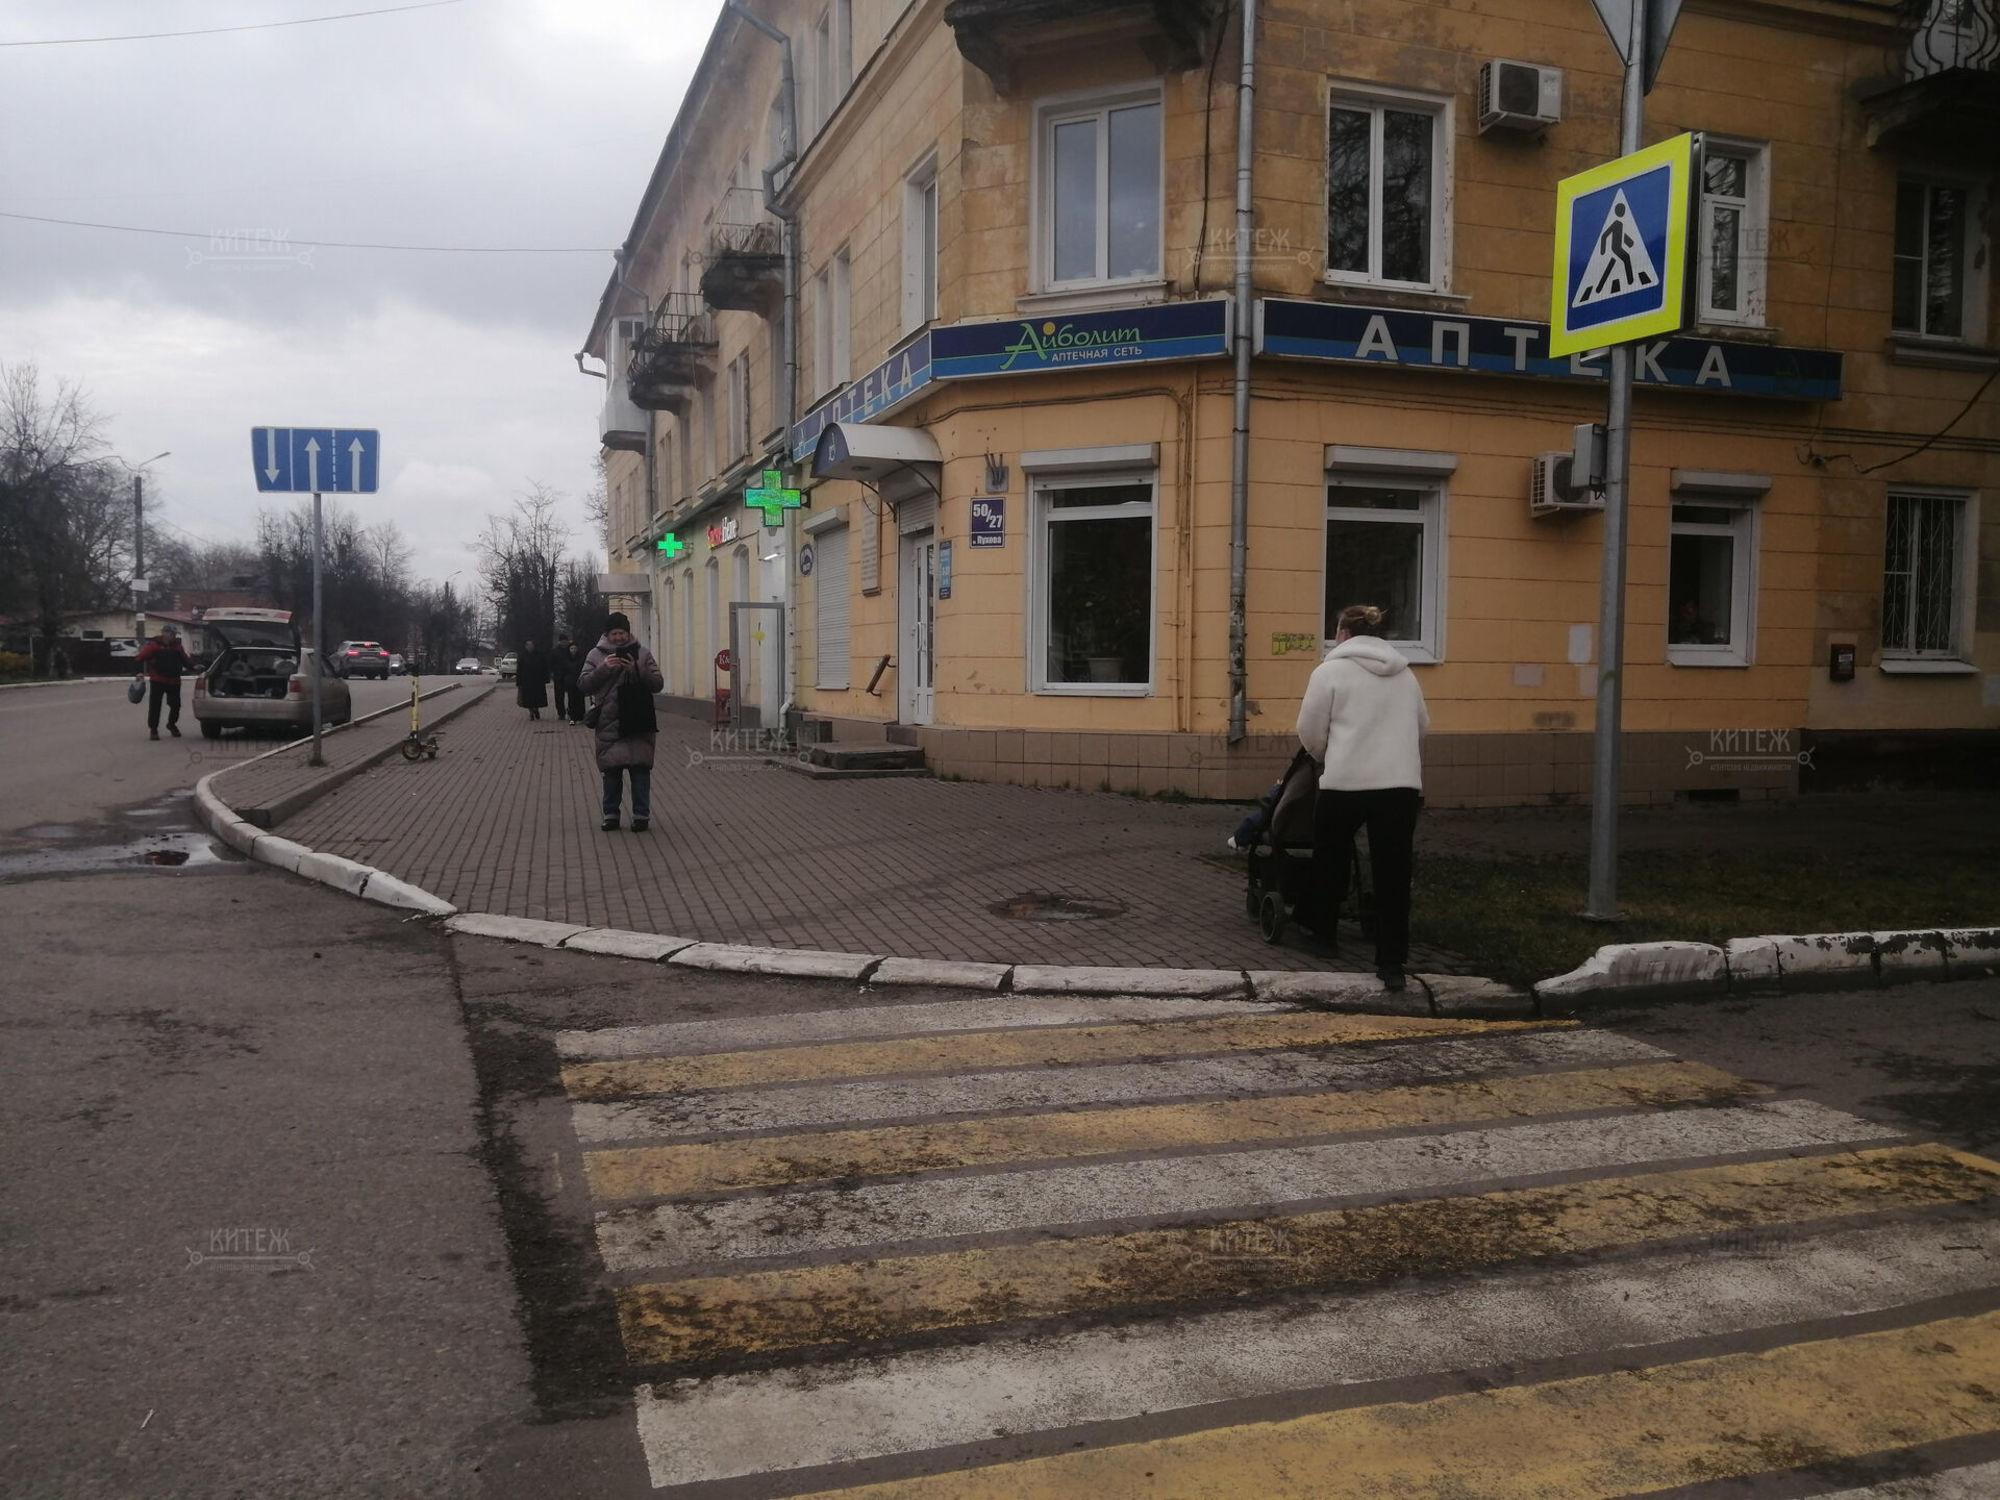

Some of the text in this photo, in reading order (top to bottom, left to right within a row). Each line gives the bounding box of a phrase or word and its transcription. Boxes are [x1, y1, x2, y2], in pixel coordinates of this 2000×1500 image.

[1000, 322, 1140, 369] Айболит
[1052, 345, 1143, 363] АПТЕЧНАЯ СЕТЬ
[973, 503, 1003, 528] 50/27
